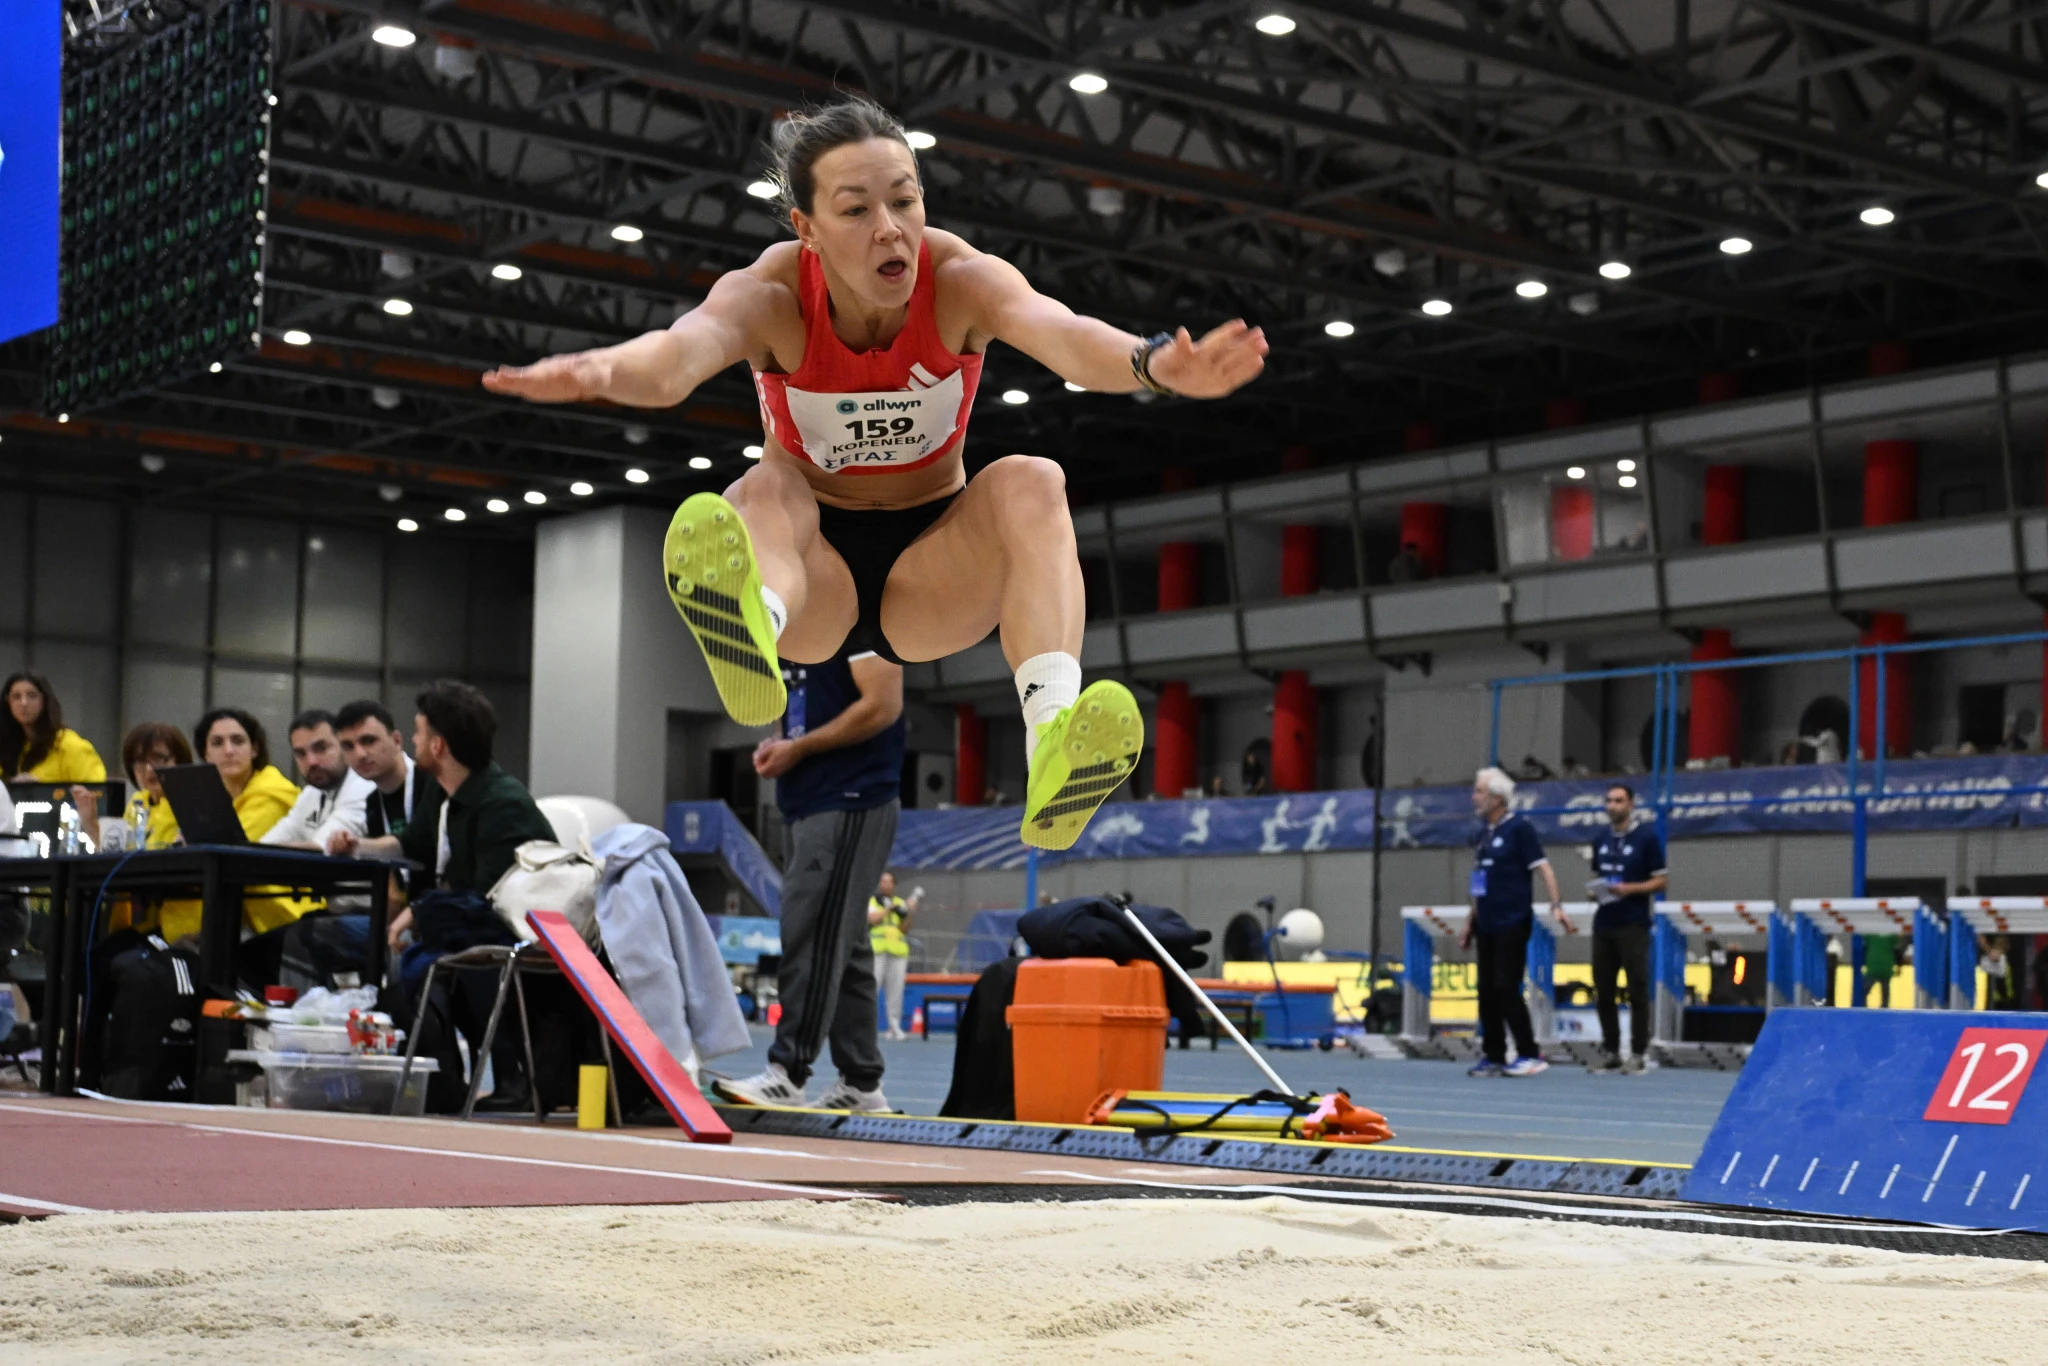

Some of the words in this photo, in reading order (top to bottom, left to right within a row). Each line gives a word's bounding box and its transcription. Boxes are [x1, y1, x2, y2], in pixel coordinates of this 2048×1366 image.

[863, 399, 922, 412] allwyn
[845, 417, 914, 441] 159
[833, 433, 926, 454] ΚΟΡΕΝΕΒΑ
[824, 450, 897, 469] ΣΕΓΑΣ
[1948, 1042, 2029, 1110] 12
